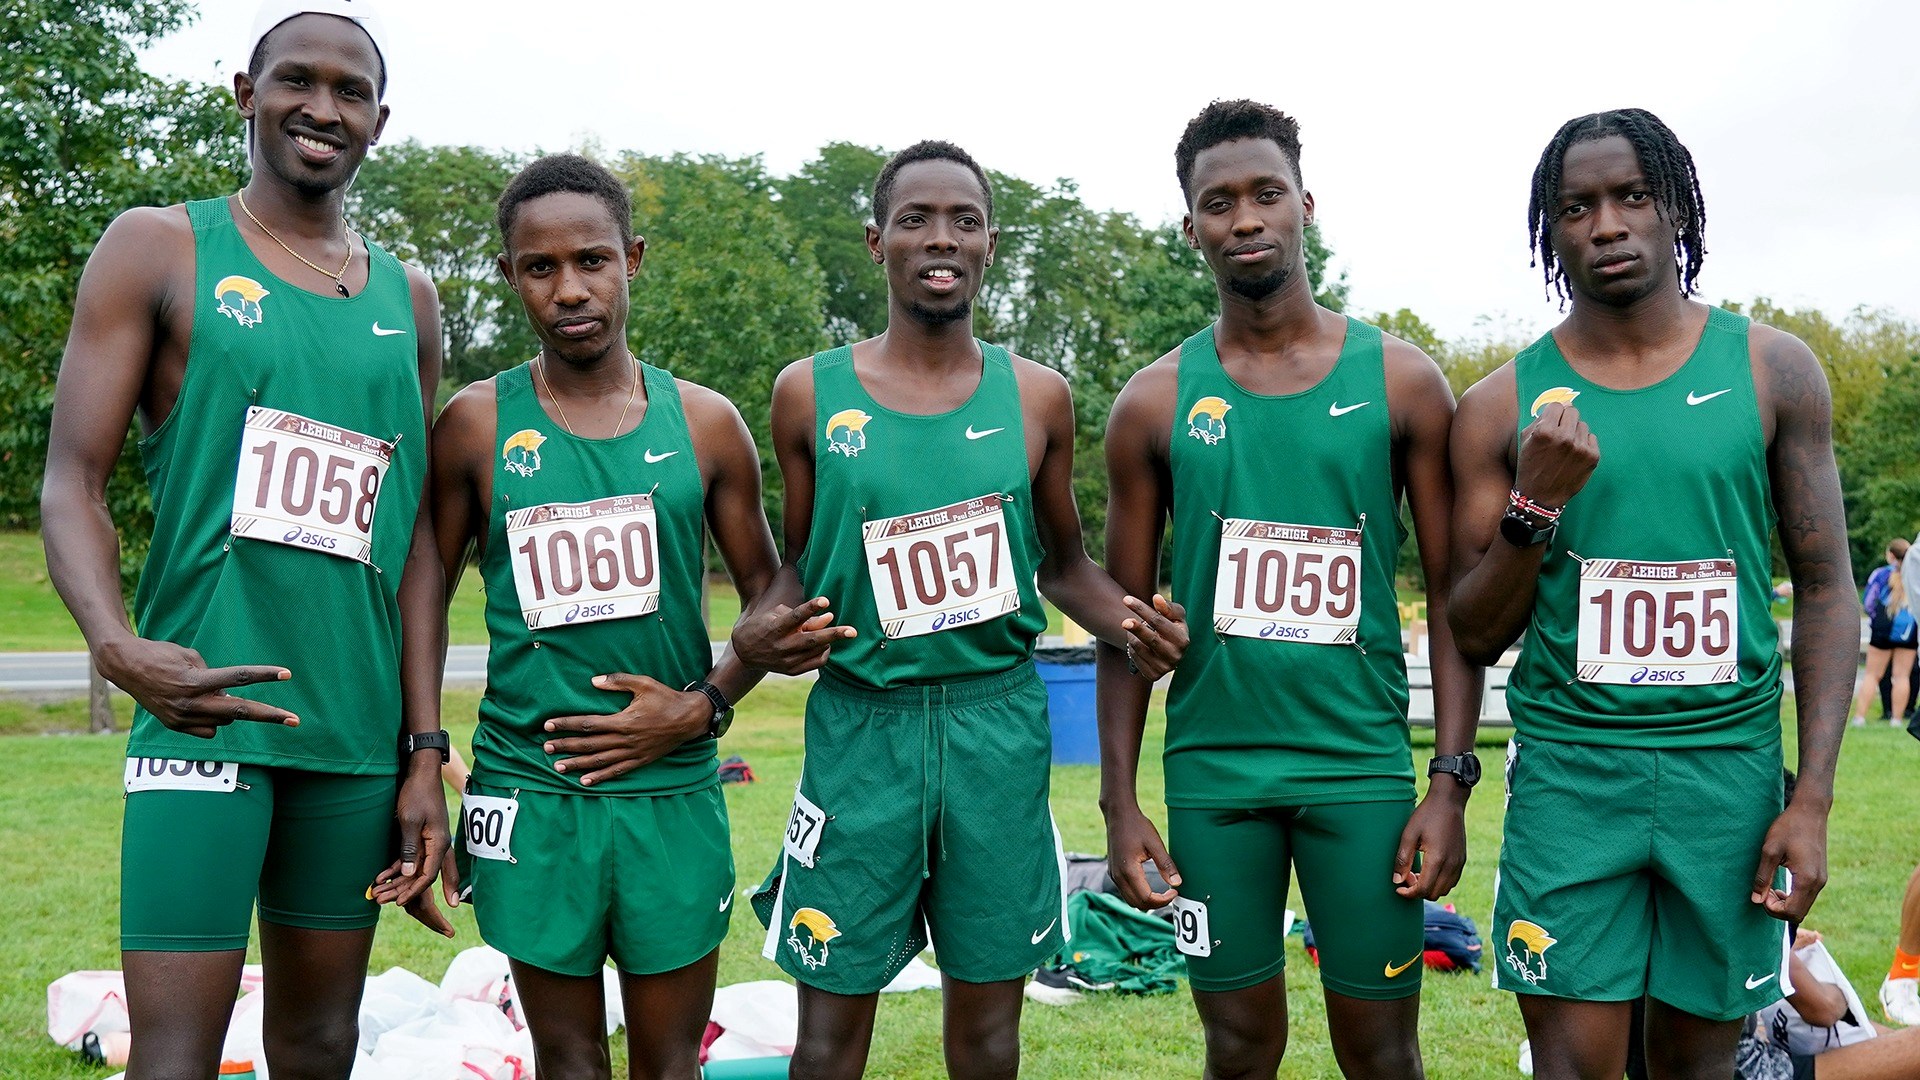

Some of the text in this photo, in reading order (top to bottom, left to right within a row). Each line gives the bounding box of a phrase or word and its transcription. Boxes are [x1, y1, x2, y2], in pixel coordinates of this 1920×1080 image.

[299, 421, 342, 443] LEHIGH
[344, 440, 360, 450] Paul
[360, 444, 380, 456] Short
[362, 437, 381, 448] 2023
[252, 440, 379, 534] 1058
[613, 497, 633, 506] 2023
[966, 499, 984, 510] 2023
[549, 506, 593, 520] LEHIGH
[596, 508, 613, 516] Paul
[613, 505, 634, 514] Short
[952, 504, 999, 522] Paul Short Run
[907, 511, 950, 531] LEHIGH
[1267, 526, 1310, 541] LEHIGH
[1312, 536, 1328, 544] Paul
[1329, 537, 1346, 545] Short
[1330, 530, 1346, 538] 2023
[519, 521, 654, 601] 1060
[877, 521, 1000, 611] 1057
[1698, 562, 1715, 570] 2023
[1632, 565, 1678, 579] LEHIGH
[1681, 572, 1697, 580] Paul
[1716, 569, 1732, 577] Run
[1228, 547, 1356, 619] 1059
[1590, 588, 1730, 658] 1055
